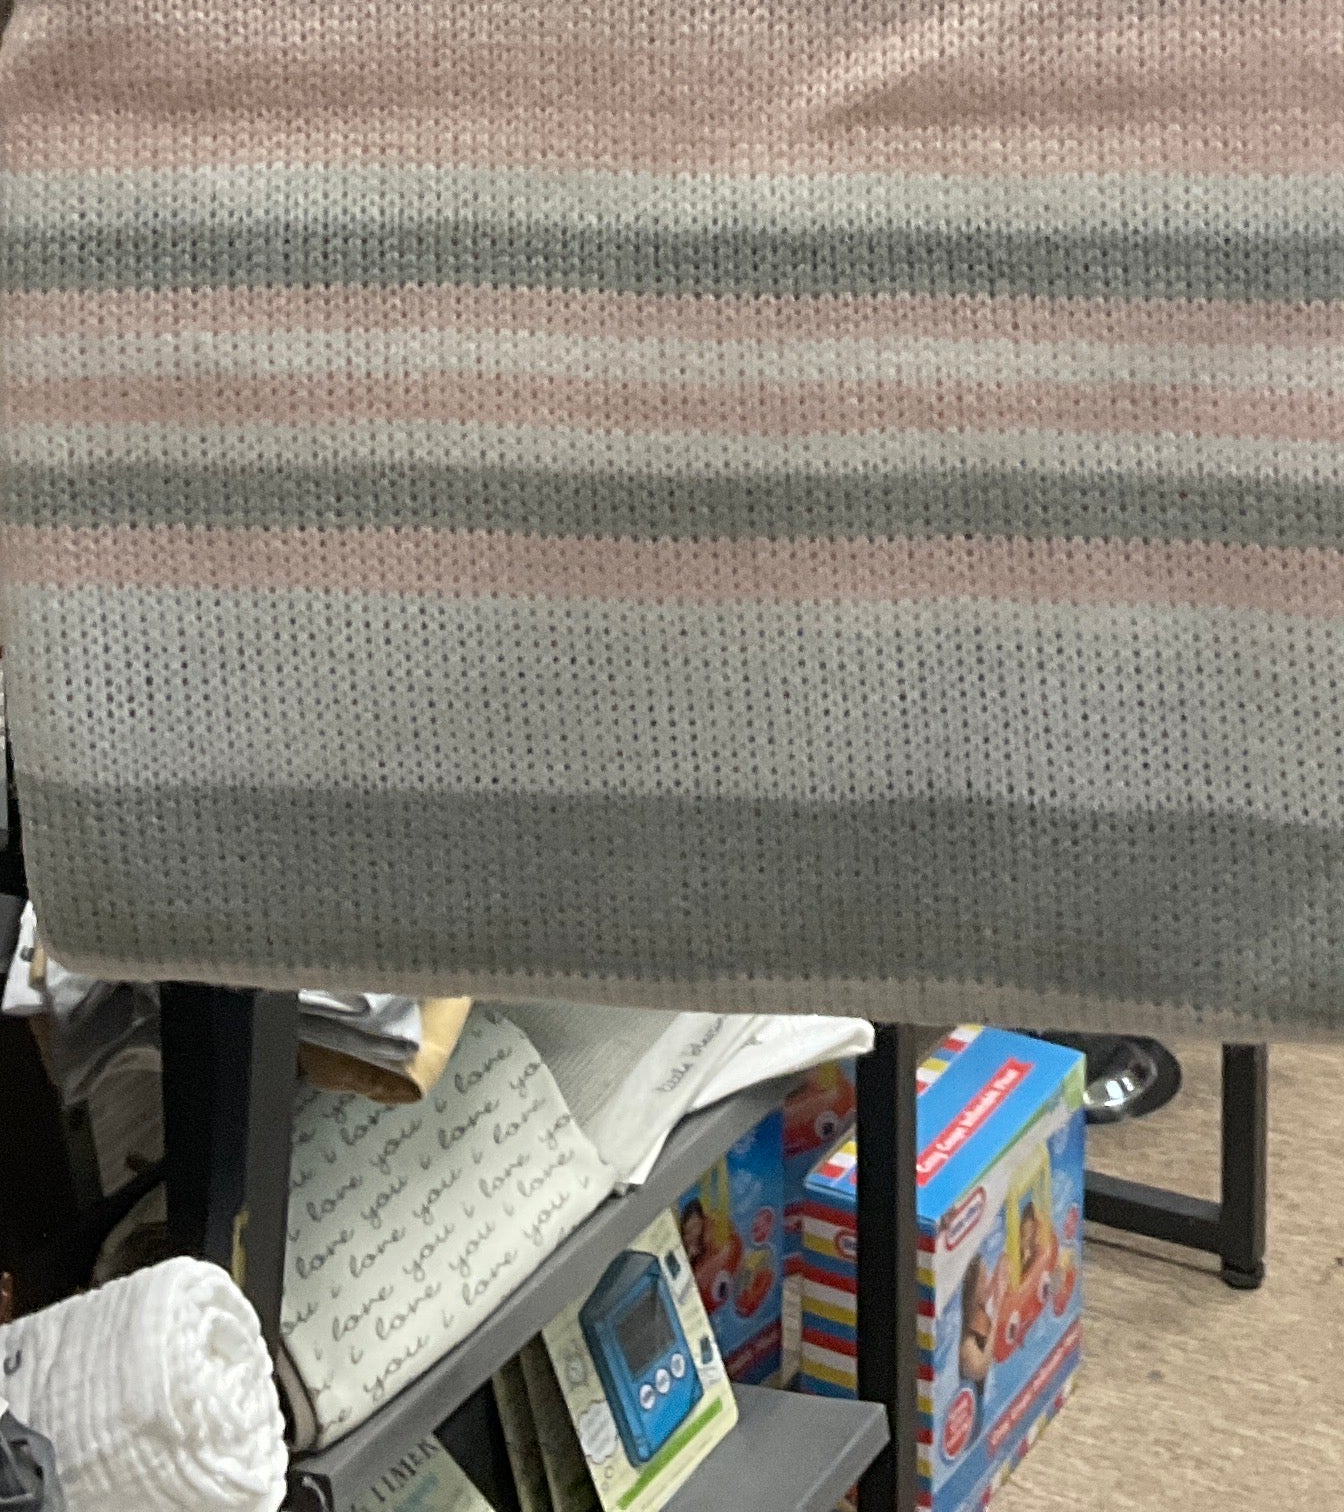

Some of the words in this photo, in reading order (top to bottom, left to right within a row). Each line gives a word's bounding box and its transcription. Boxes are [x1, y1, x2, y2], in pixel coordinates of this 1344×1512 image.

[295, 1228, 355, 1280] love
[359, 1175, 409, 1230] you
[438, 1098, 500, 1150] love
[306, 1175, 364, 1222] love
[369, 1118, 424, 1176] you
[454, 1047, 513, 1094] love
[349, 1226, 407, 1278] love
[412, 1167, 463, 1226] you
[492, 1096, 547, 1145] love
[331, 1285, 395, 1342] love
[402, 1223, 455, 1283] you
[478, 1153, 531, 1198] love
[362, 1335, 430, 1402] you
[461, 1249, 519, 1306] love
[520, 1191, 571, 1248] you
[375, 1281, 442, 1341] love
[448, 1221, 497, 1279] you
[516, 1148, 576, 1198] love
